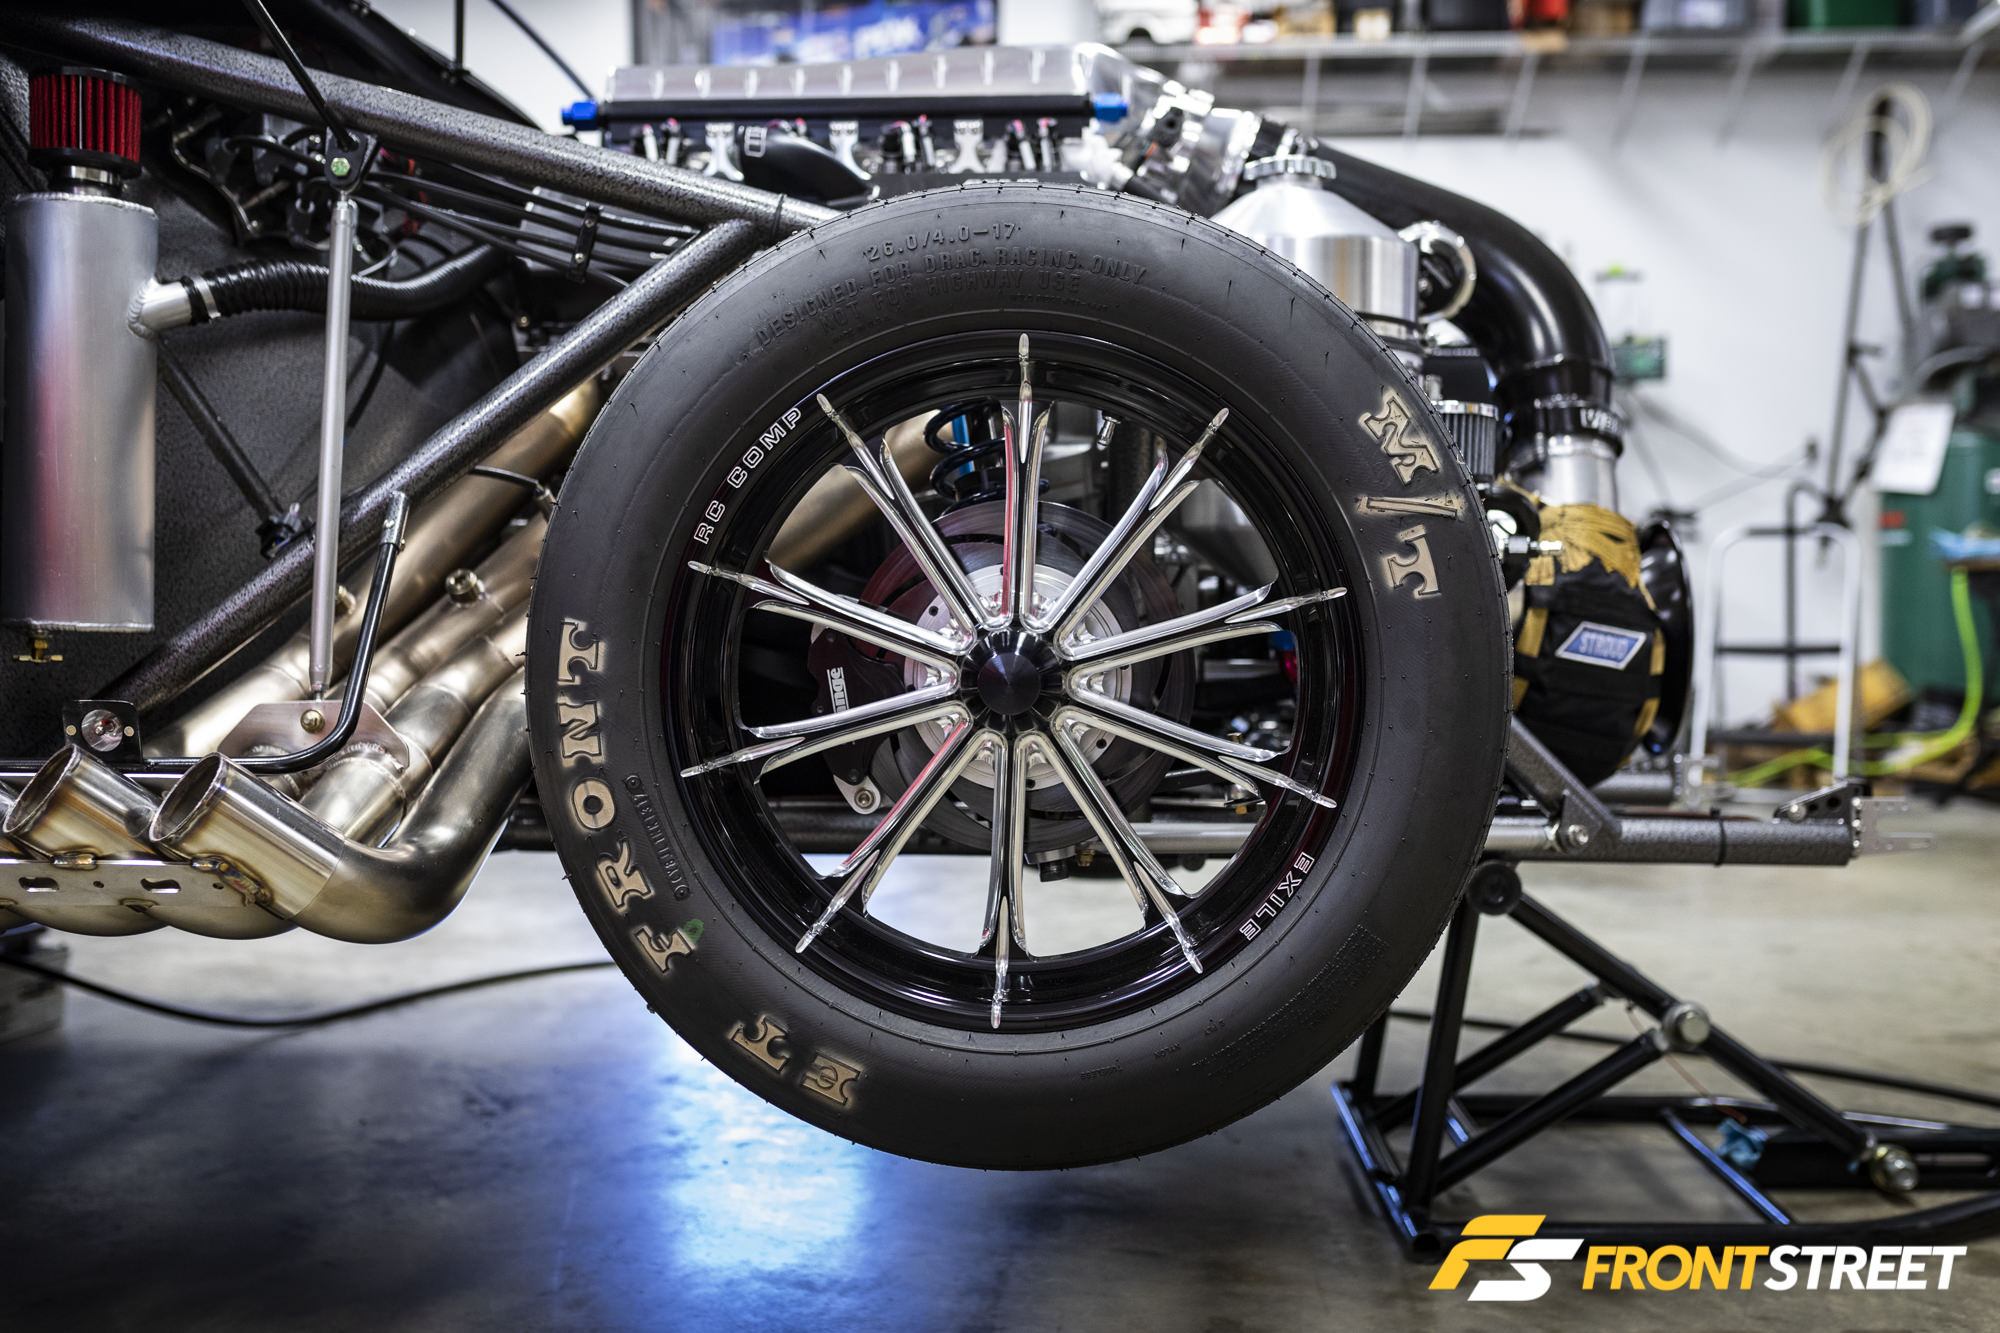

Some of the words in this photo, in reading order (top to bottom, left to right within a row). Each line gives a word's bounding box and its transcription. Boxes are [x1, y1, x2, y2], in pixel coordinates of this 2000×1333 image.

[756, 279, 860, 347] DESIGNED
[870, 260, 912, 288] FOR
[924, 248, 981, 274] DRAG
[995, 246, 1078, 270] RACING
[1090, 254, 1148, 285] ONLY
[820, 301, 859, 332] NOT
[872, 282, 913, 312] FOR
[926, 270, 1024, 297] HIGHWAY
[1039, 270, 1081, 294] USE
[693, 500, 726, 545] RC
[727, 407, 802, 489] COMP
[1355, 389, 1464, 599] M/T
[1239, 851, 1315, 941] EXILE
